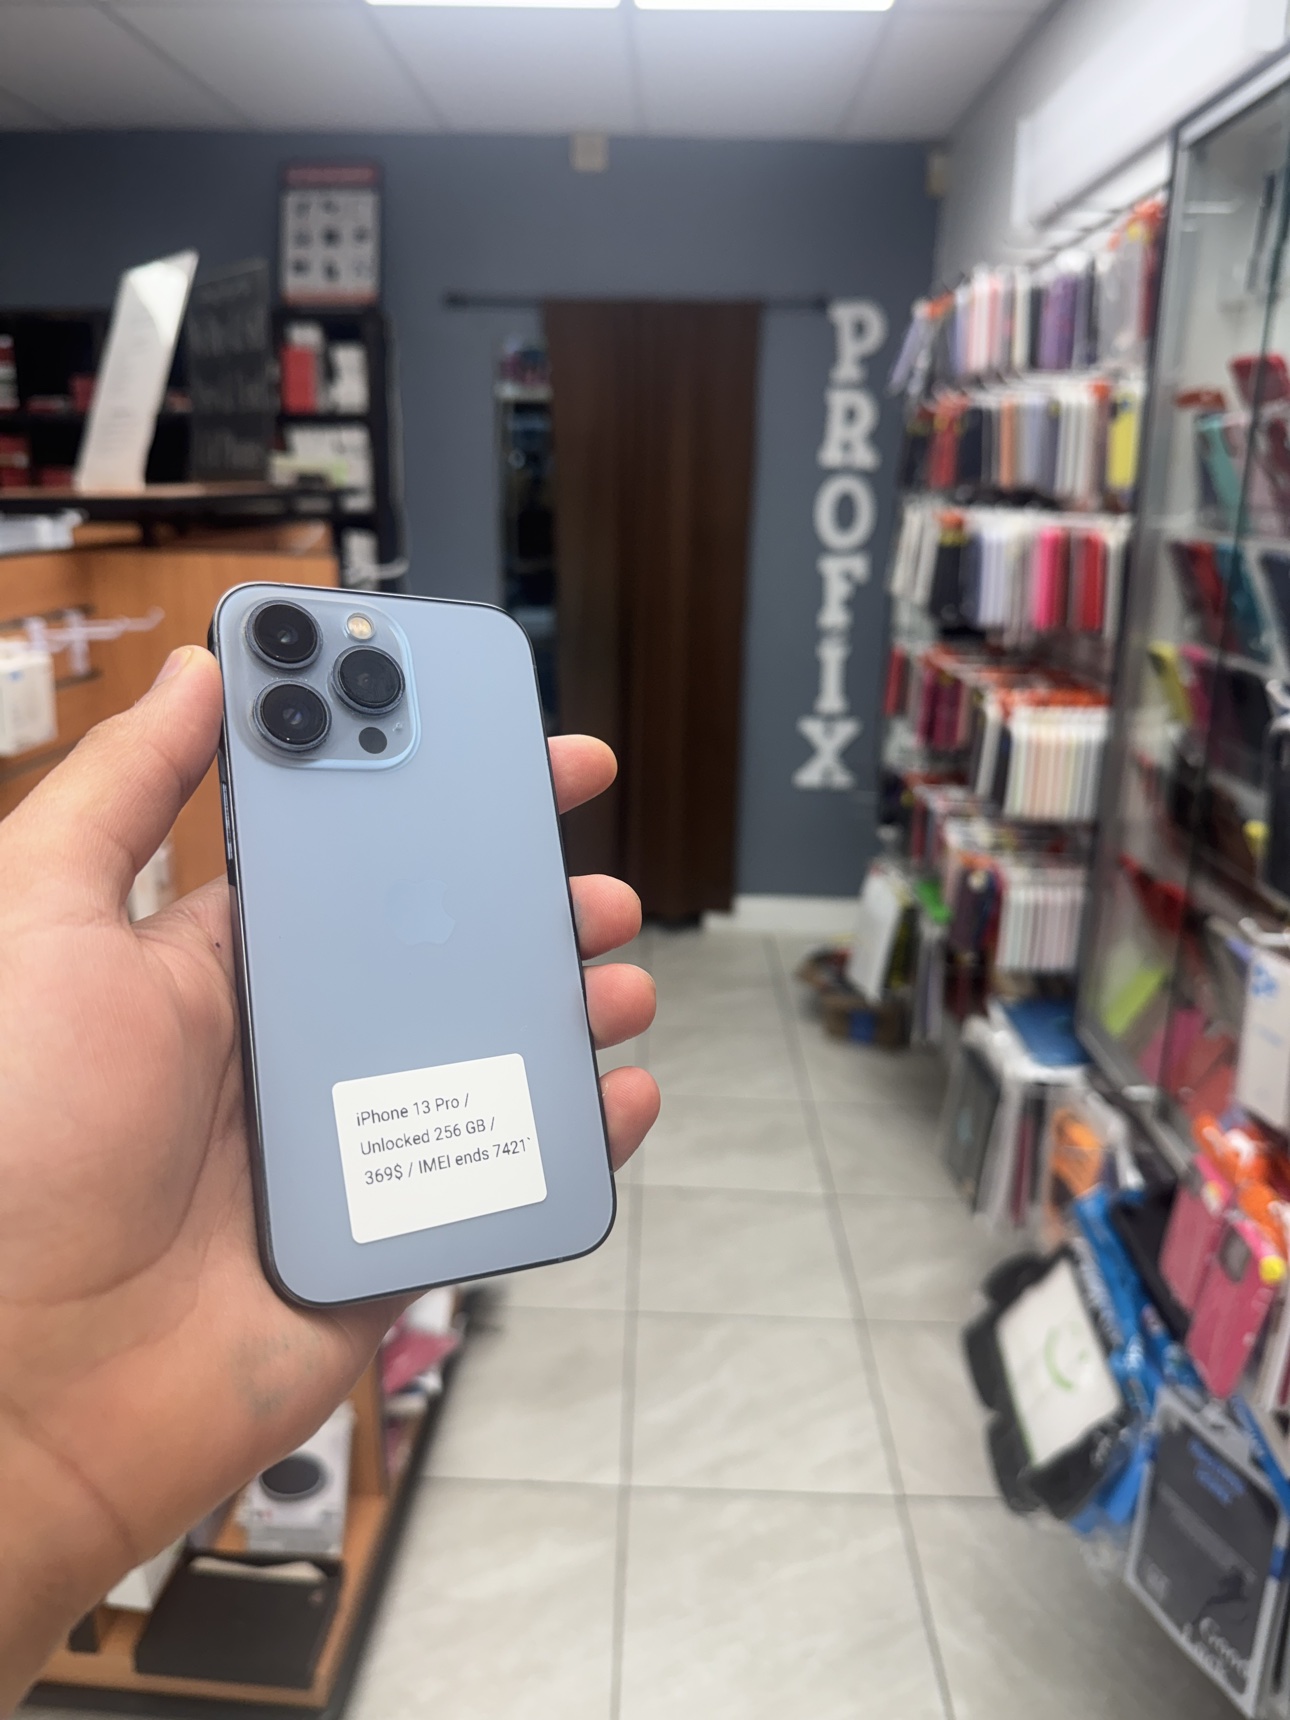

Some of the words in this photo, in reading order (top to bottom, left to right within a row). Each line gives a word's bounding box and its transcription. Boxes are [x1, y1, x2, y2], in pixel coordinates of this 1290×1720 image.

[793, 301, 888, 790] PROFIX
[356, 1106, 409, 1127] iPhone
[413, 1100, 431, 1116] 13
[435, 1097, 460, 1112] Pro
[360, 1129, 430, 1155] Unlocked
[434, 1123, 462, 1141] 256
[465, 1118, 486, 1135] GB
[364, 1163, 403, 1185] 369$
[418, 1154, 451, 1174] IMEI
[455, 1147, 490, 1166] ends
